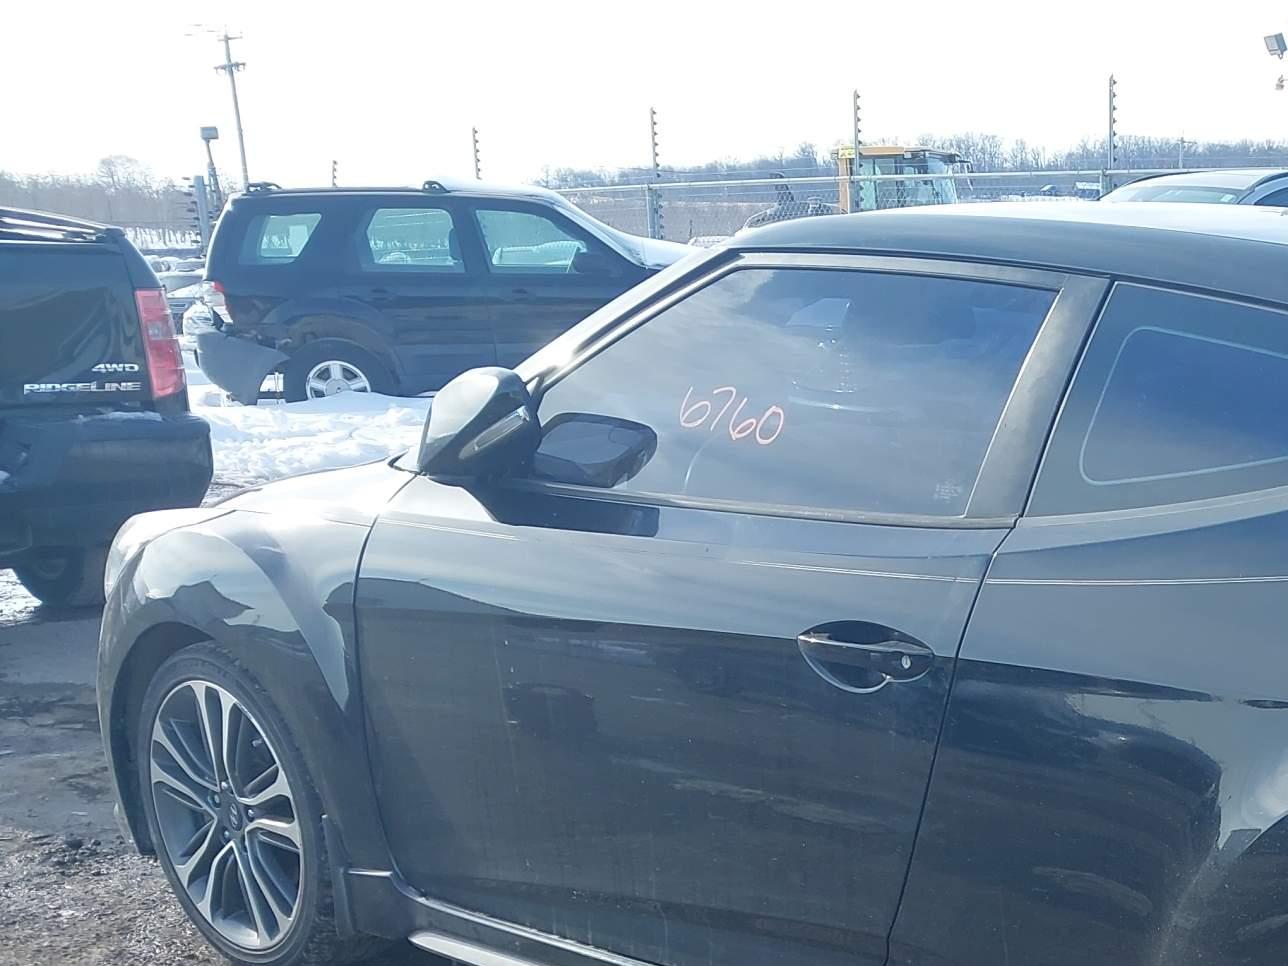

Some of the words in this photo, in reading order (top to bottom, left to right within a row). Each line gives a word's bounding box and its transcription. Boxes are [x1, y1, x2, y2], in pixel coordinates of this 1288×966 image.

[91, 363, 140, 373] 4WD
[23, 381, 142, 395] RIDGELINE
[680, 386, 784, 445] 6760
